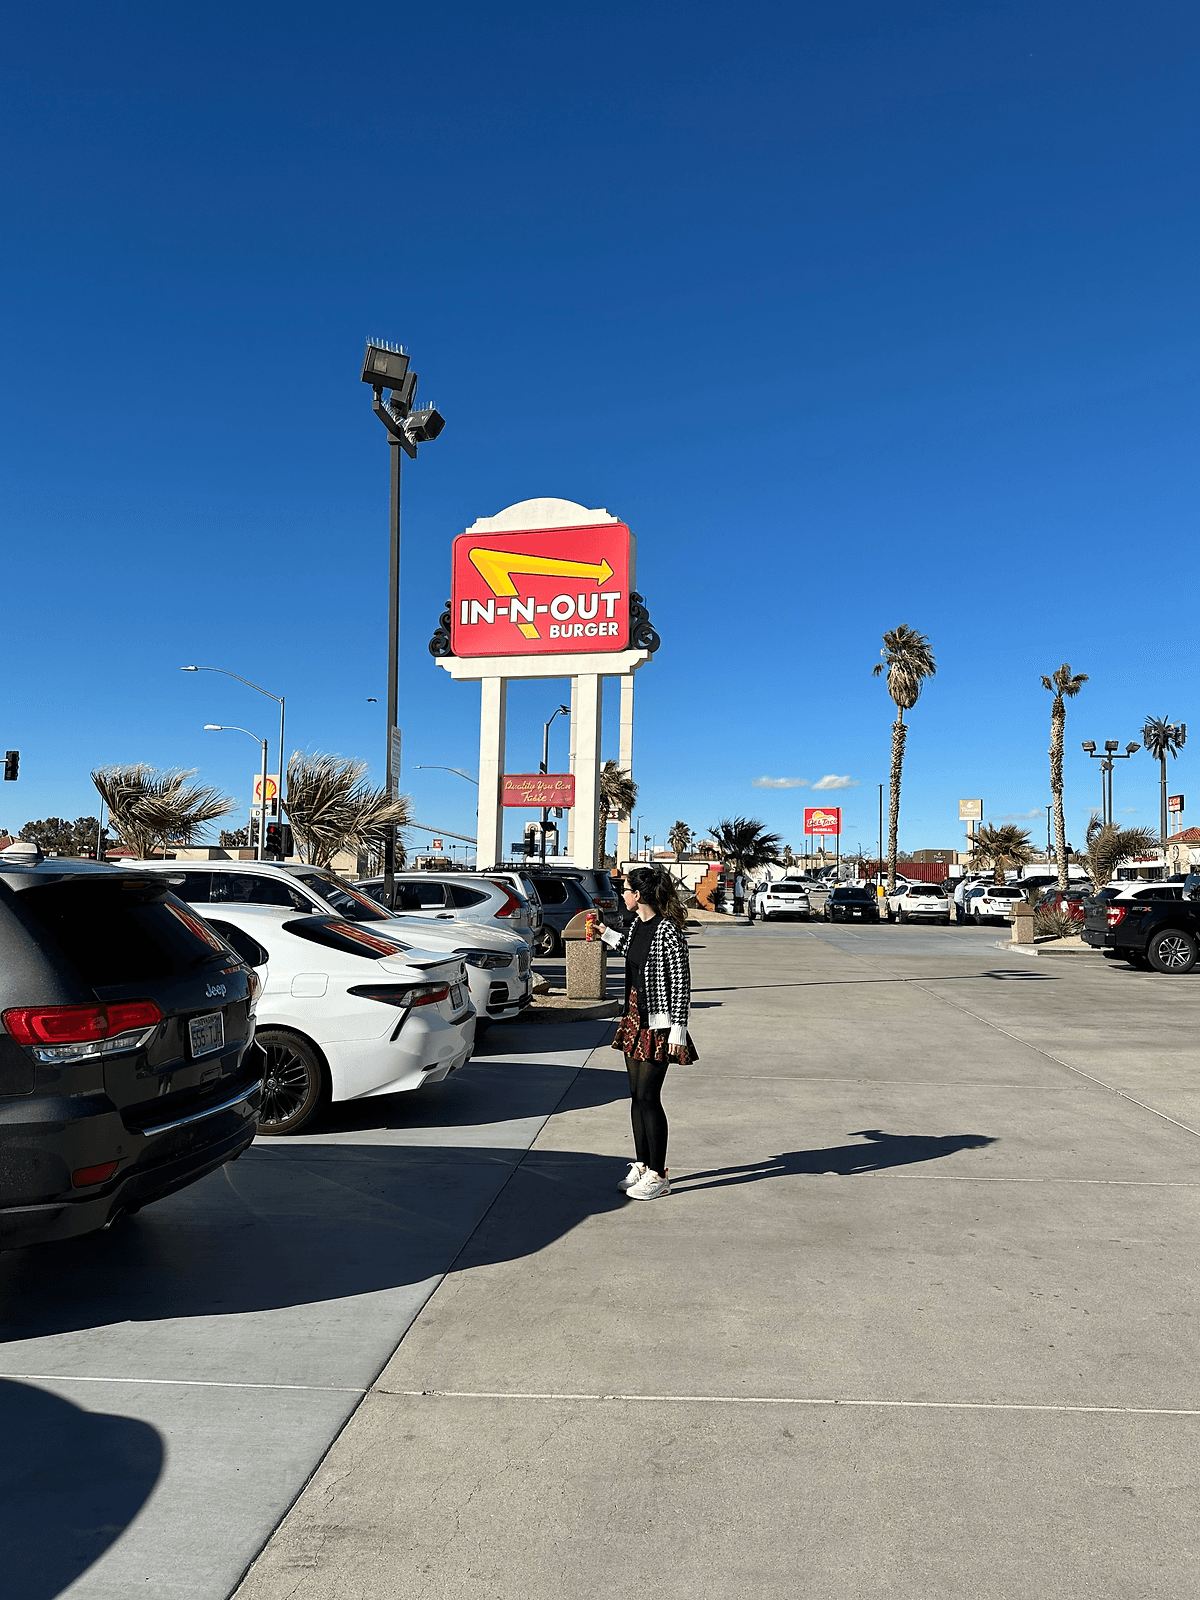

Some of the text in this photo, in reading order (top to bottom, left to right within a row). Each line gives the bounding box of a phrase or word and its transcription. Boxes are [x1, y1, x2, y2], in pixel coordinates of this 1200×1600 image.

[460, 592, 621, 625] IN-N-OUT
[549, 622, 619, 639] BURGER
[505, 780, 571, 792] Quality You Can
[521, 790, 547, 802] Taste
[205, 983, 227, 998] Jeep
